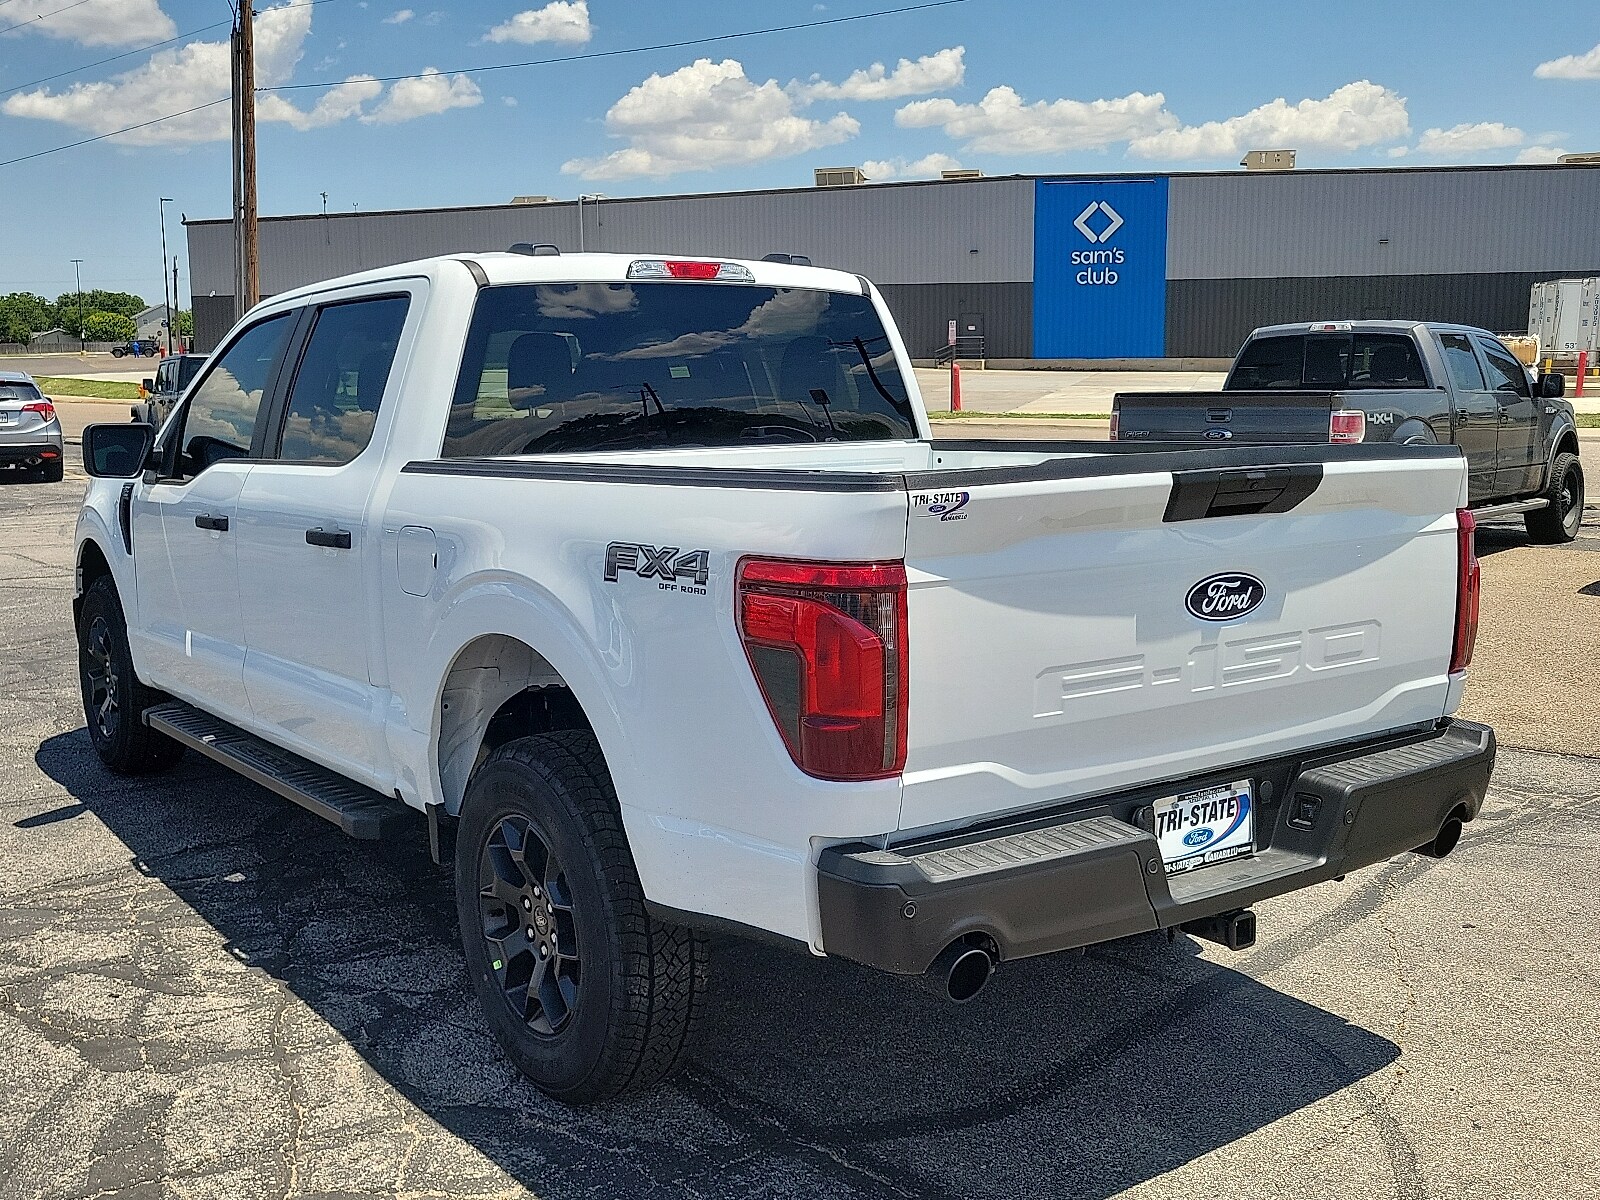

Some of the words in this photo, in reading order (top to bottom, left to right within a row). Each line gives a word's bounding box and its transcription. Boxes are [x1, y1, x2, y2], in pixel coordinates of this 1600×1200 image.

[1071, 247, 1125, 265] sam's
[1076, 267, 1118, 285] club
[912, 493, 961, 508] TRI-STATE
[603, 541, 710, 586] FX4
[658, 582, 678, 591] OFF
[680, 585, 707, 595] ROAD
[1202, 580, 1253, 614] Ford
[1032, 618, 1383, 719] F-150
[1157, 797, 1236, 840] TRI-STATE
